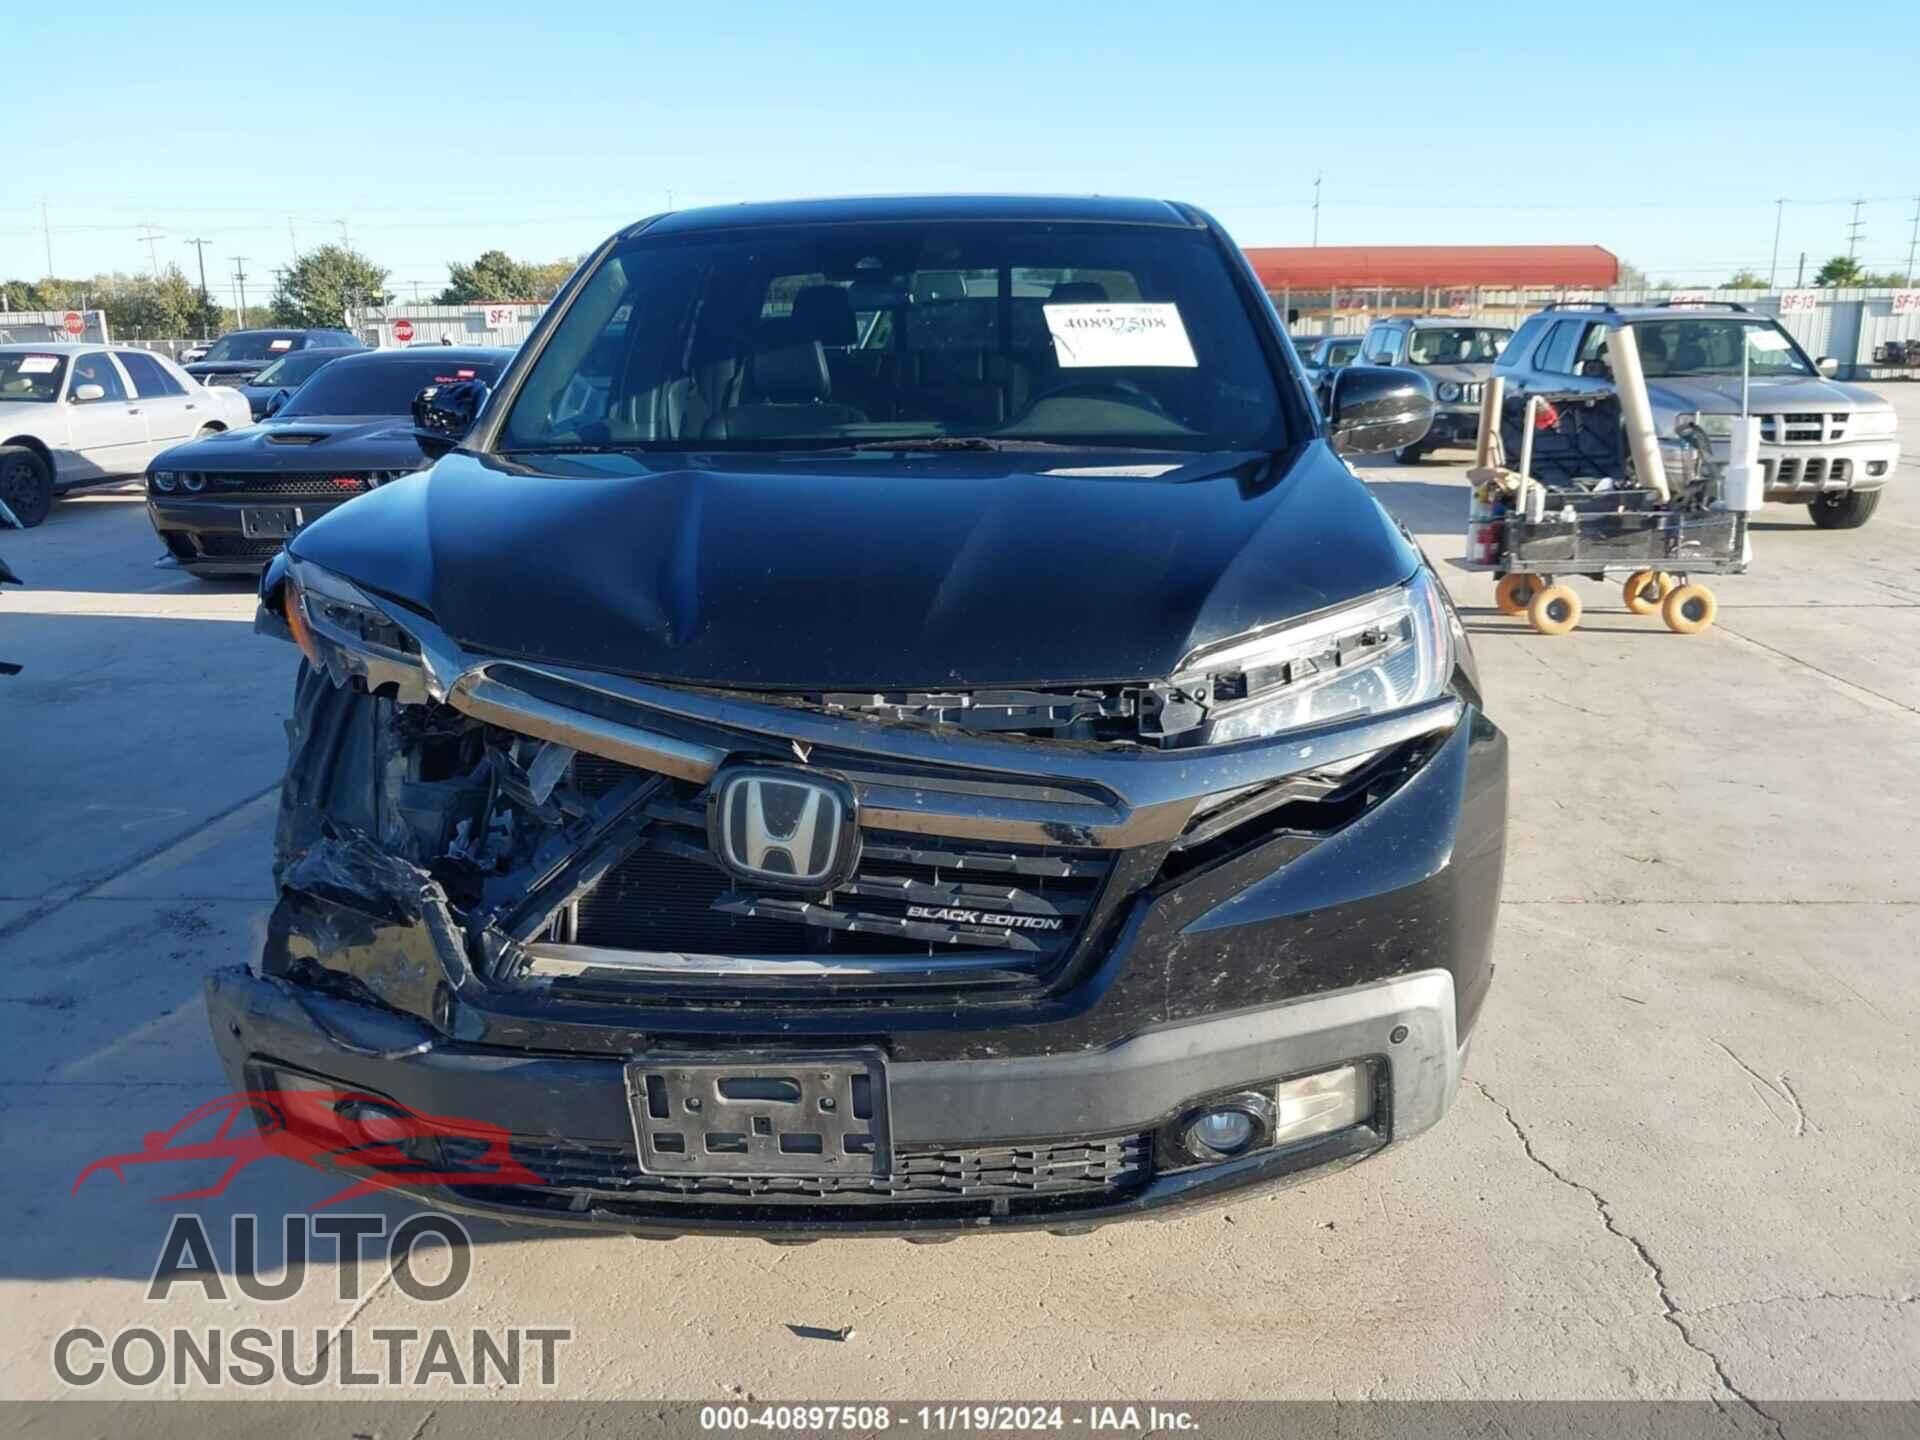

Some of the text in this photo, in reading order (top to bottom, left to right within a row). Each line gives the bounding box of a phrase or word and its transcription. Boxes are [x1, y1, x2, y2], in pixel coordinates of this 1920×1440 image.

[1782, 295, 1815, 309] SF-13
[1895, 294, 1920, 309] SF-1
[490, 310, 513, 324] SF-1
[906, 904, 1063, 931] BLACK EDITION
